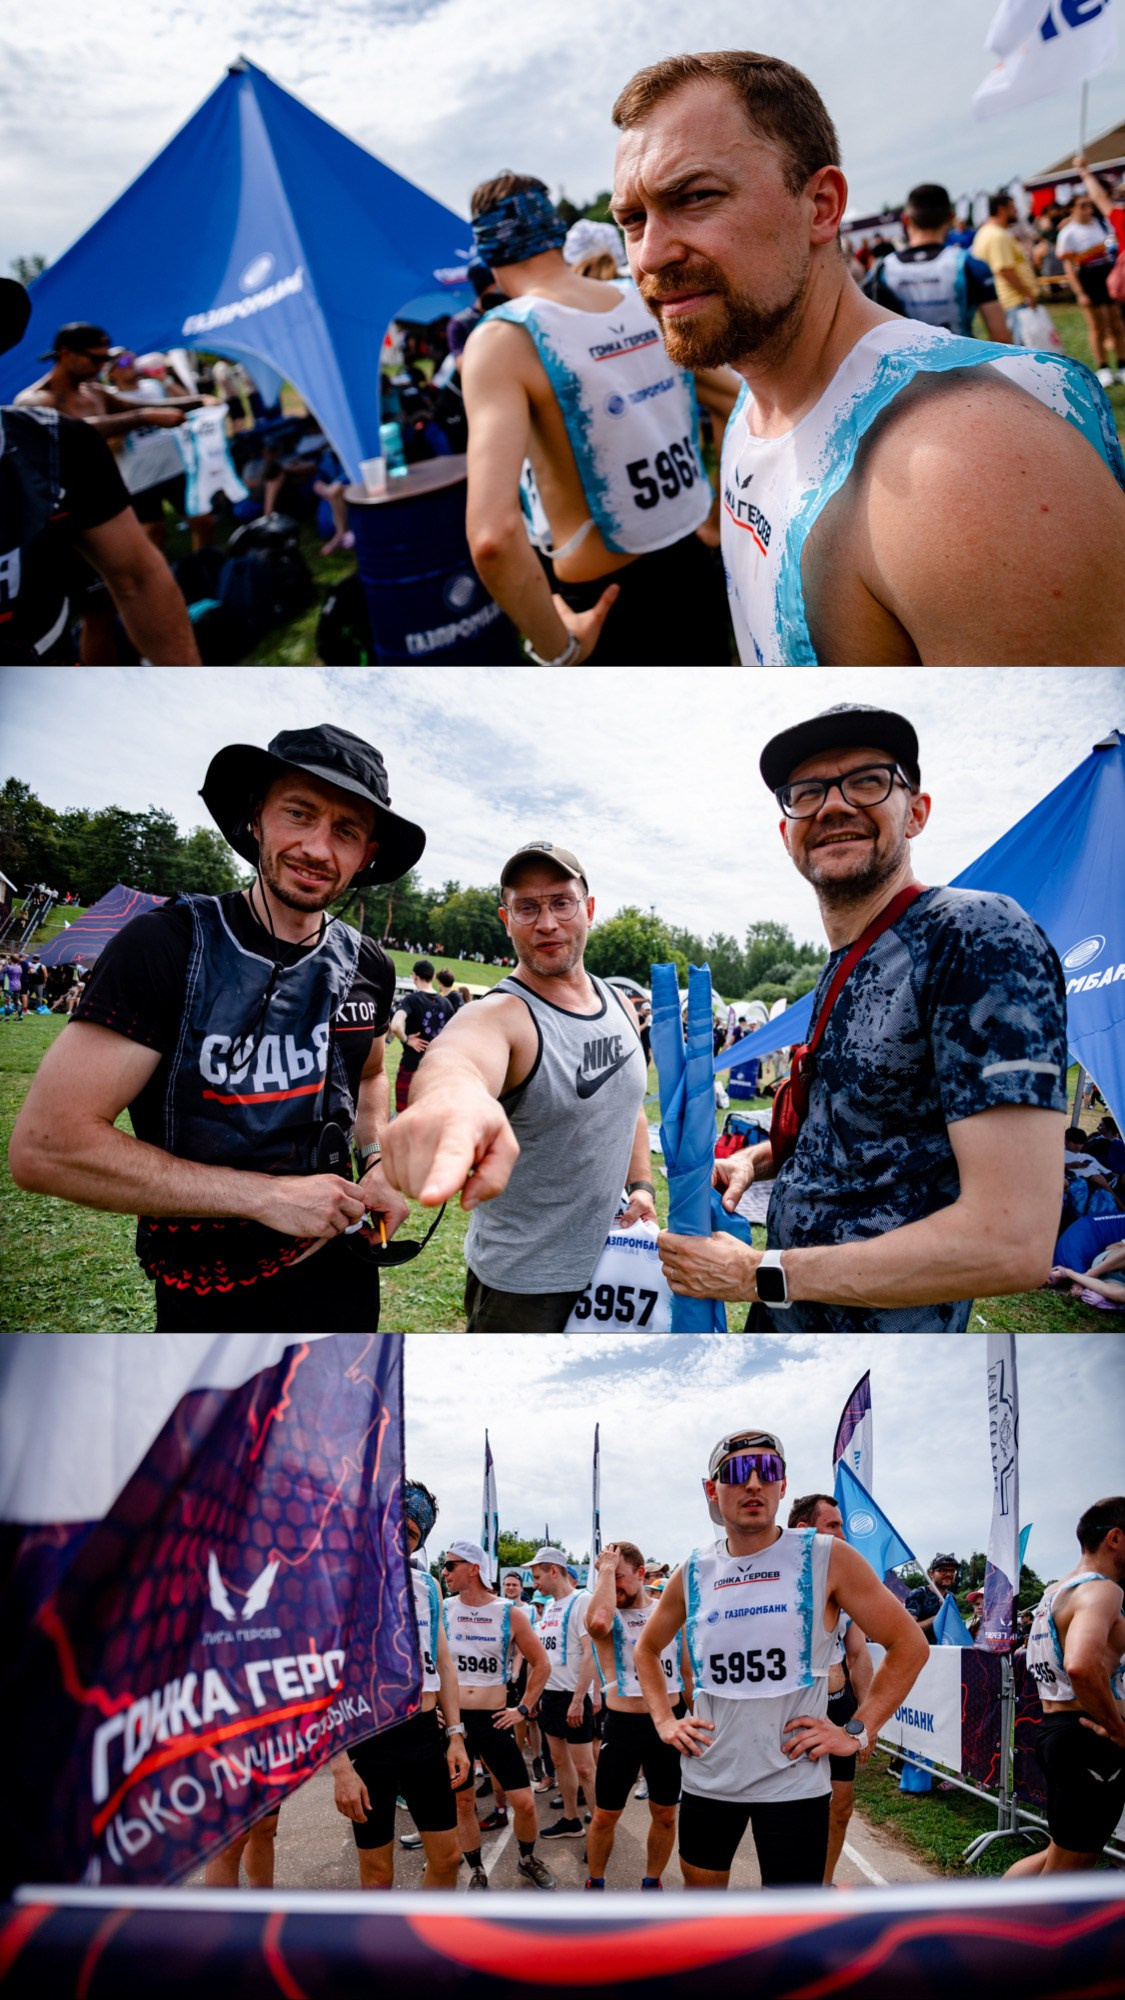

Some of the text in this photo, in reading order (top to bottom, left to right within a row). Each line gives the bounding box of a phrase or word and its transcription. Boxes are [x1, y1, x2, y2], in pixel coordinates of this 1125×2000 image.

[737, 500, 772, 547] ГЕРОЕВ
[199, 1022, 329, 1092] СУДЬЯ
[583, 1035, 624, 1073] NIKE
[575, 1283, 658, 1327] 5957
[714, 1571, 780, 1588] ГОНКА ГЕРОЕВ
[724, 1604, 788, 1619] ГАЗПРОМБАНК
[458, 1655, 498, 1674] 5948
[709, 1648, 787, 1685] 5953
[91, 1667, 240, 1804] ГОНКА
[891, 1706, 935, 1733] ОМБАНК
